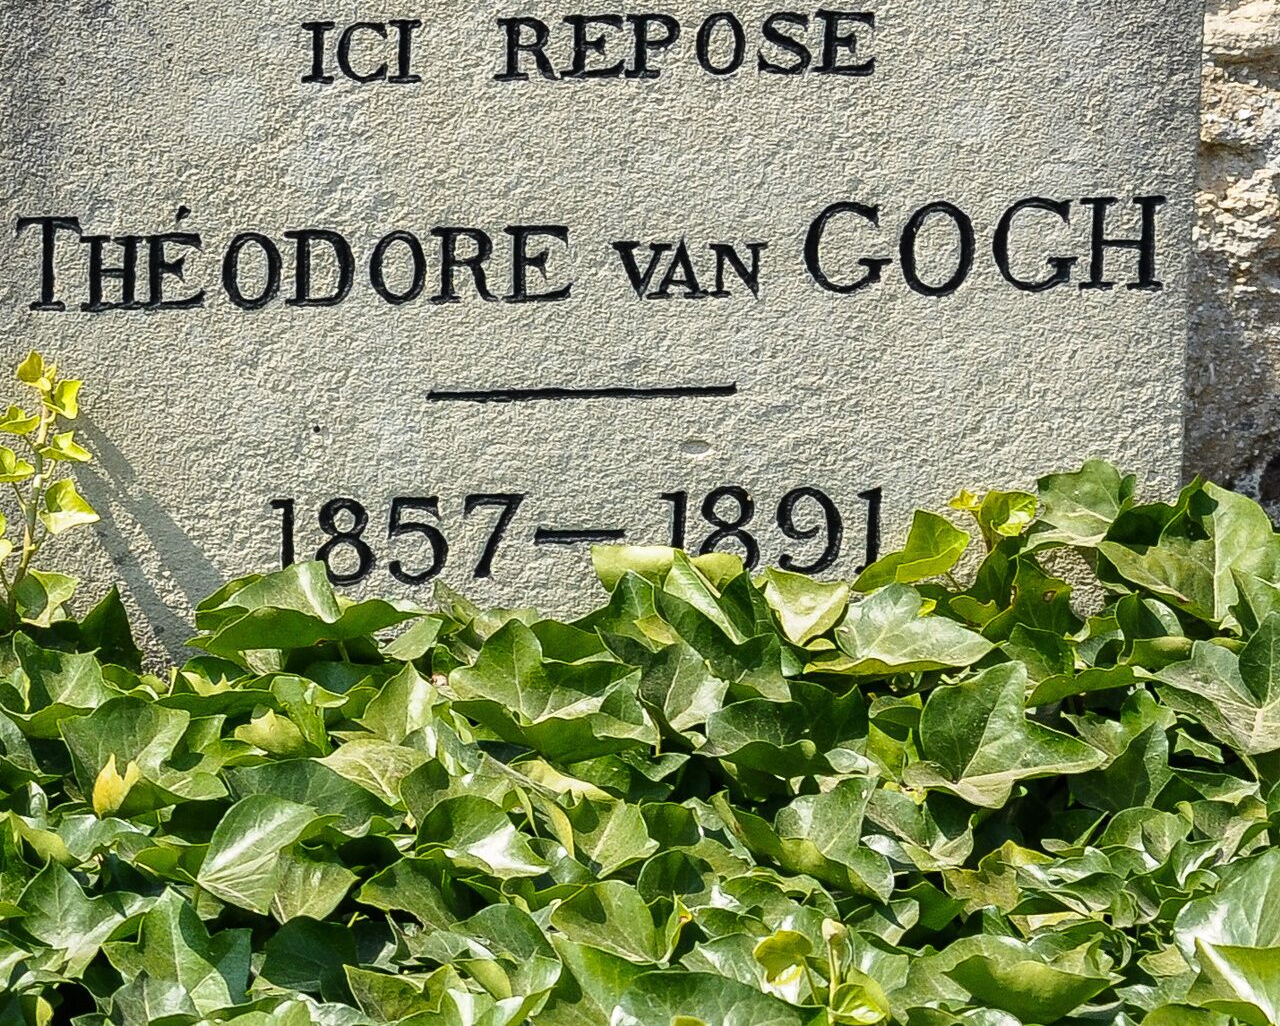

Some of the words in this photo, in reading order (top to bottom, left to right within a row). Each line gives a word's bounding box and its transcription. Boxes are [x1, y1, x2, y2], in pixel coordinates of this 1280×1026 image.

[302, 19, 421, 84] ICI
[495, 10, 875, 82] REPOSE
[16, 206, 571, 314] THÉODORE
[613, 241, 766, 299] VAN
[804, 195, 1167, 296] GOGH
